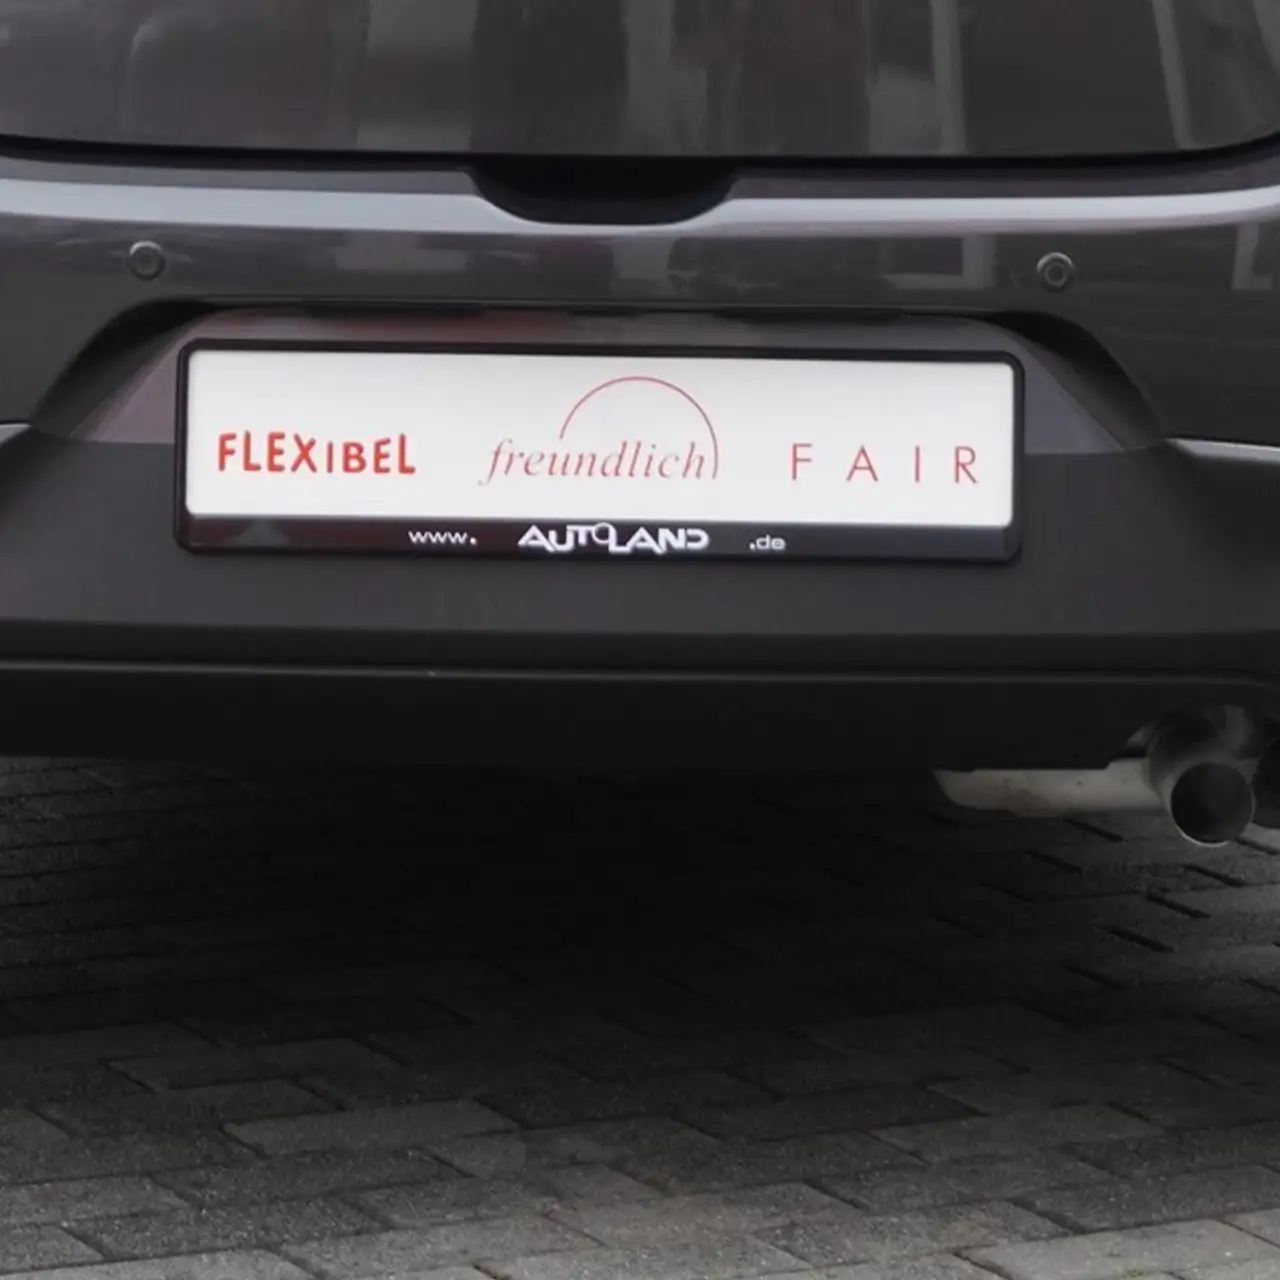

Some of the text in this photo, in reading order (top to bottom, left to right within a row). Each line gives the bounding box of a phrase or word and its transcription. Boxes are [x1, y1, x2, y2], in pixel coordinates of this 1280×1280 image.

[218, 430, 417, 475] FLEXIBEL
[477, 437, 708, 487] freundlich
[517, 522, 710, 556] AUTOLAND
